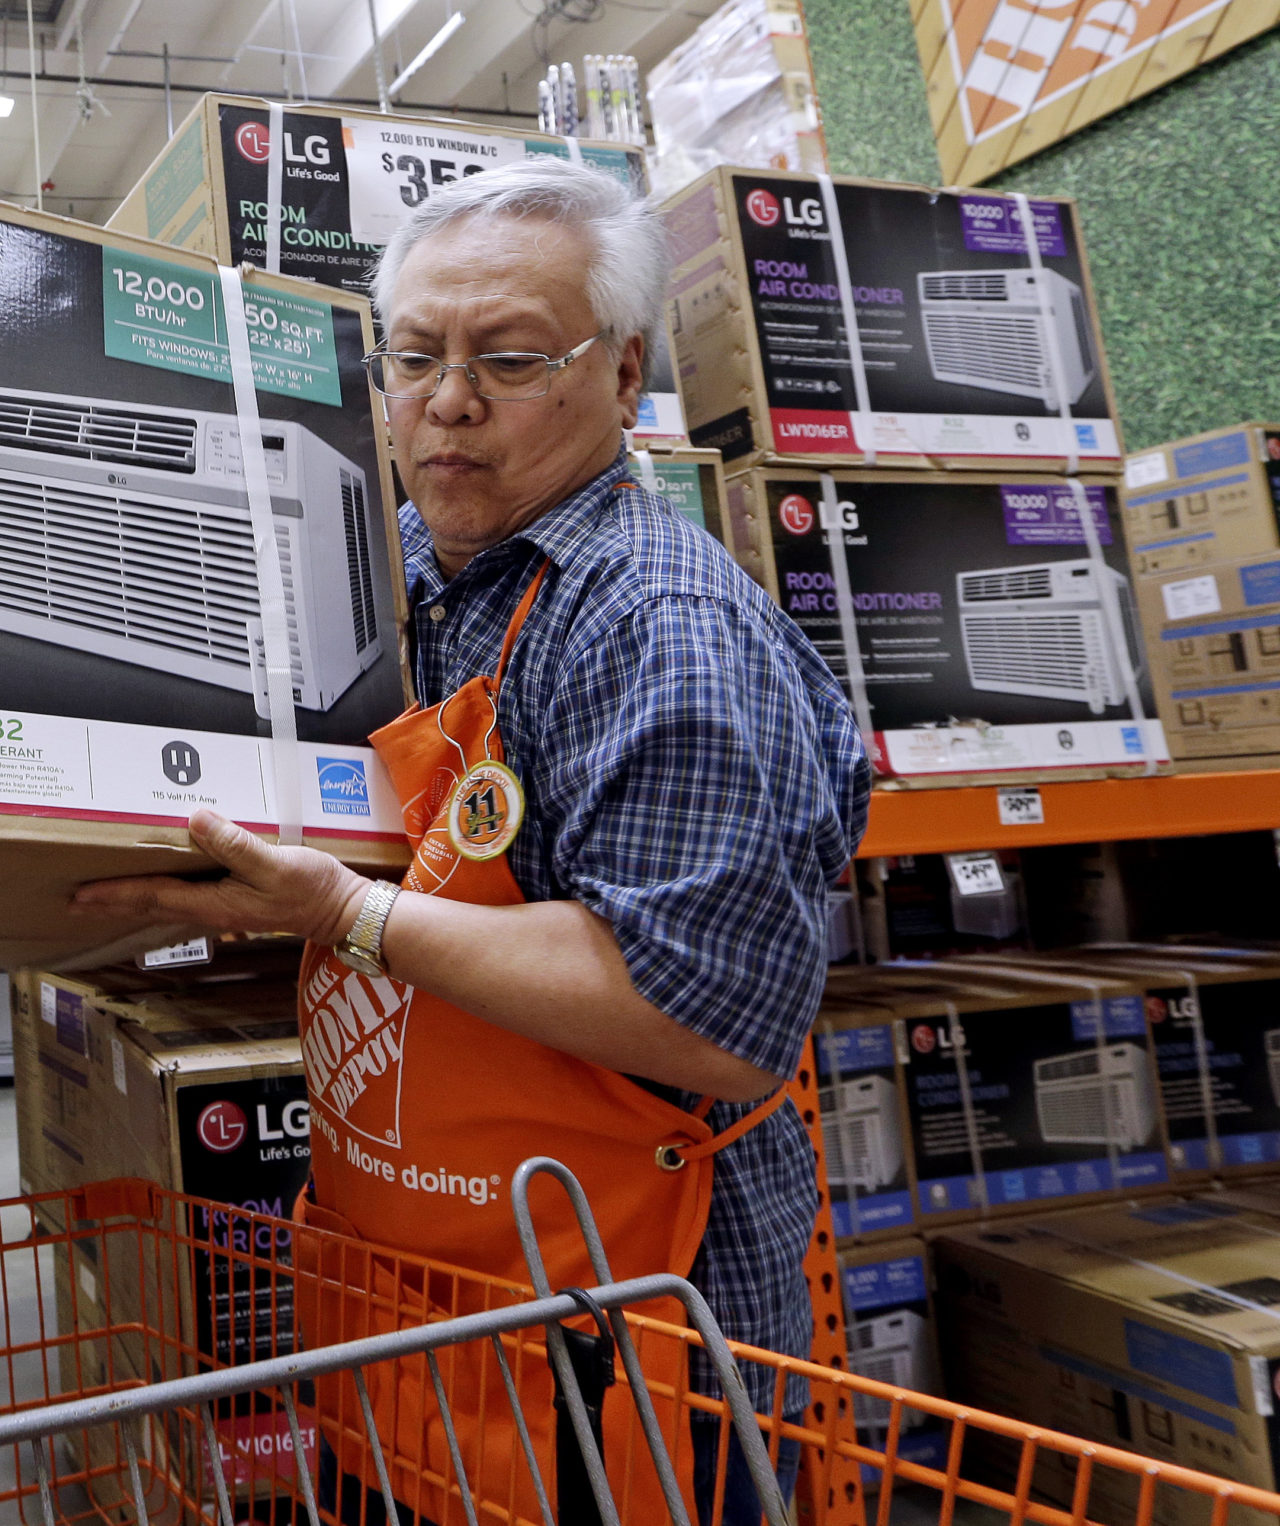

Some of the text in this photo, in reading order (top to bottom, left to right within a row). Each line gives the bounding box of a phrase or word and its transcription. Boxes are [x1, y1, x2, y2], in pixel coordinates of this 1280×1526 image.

[283, 132, 331, 165] LG
[416, 136, 435, 148] BTU
[437, 138, 479, 154] WINDOW
[480, 143, 498, 157] A/C
[287, 167, 340, 182] Life's Good
[783, 197, 823, 226] LG
[327, 255, 340, 264] DE
[341, 257, 362, 266] AIRE
[754, 259, 808, 279] ROOM
[112, 268, 204, 310] 12,000
[758, 280, 903, 304] AIR CONDIONER
[136, 302, 186, 327] BTU/hr
[131, 334, 156, 348] FITS
[159, 340, 218, 362] WINDOWS:
[146, 349, 164, 360] Para
[304, 373, 313, 384] H
[818, 501, 859, 530] LG
[789, 592, 943, 611] AIR CNDITIONER
[152, 790, 165, 800] 115
[199, 794, 218, 805] Amp
[323, 802, 370, 815] ENERGY STAR
[464, 785, 499, 837] 11
[330, 1020, 401, 1118] DEPOT
[257, 1100, 311, 1142] LG
[260, 1146, 311, 1161] Life's Go
[310, 1105, 498, 1206] aving. More doing.
